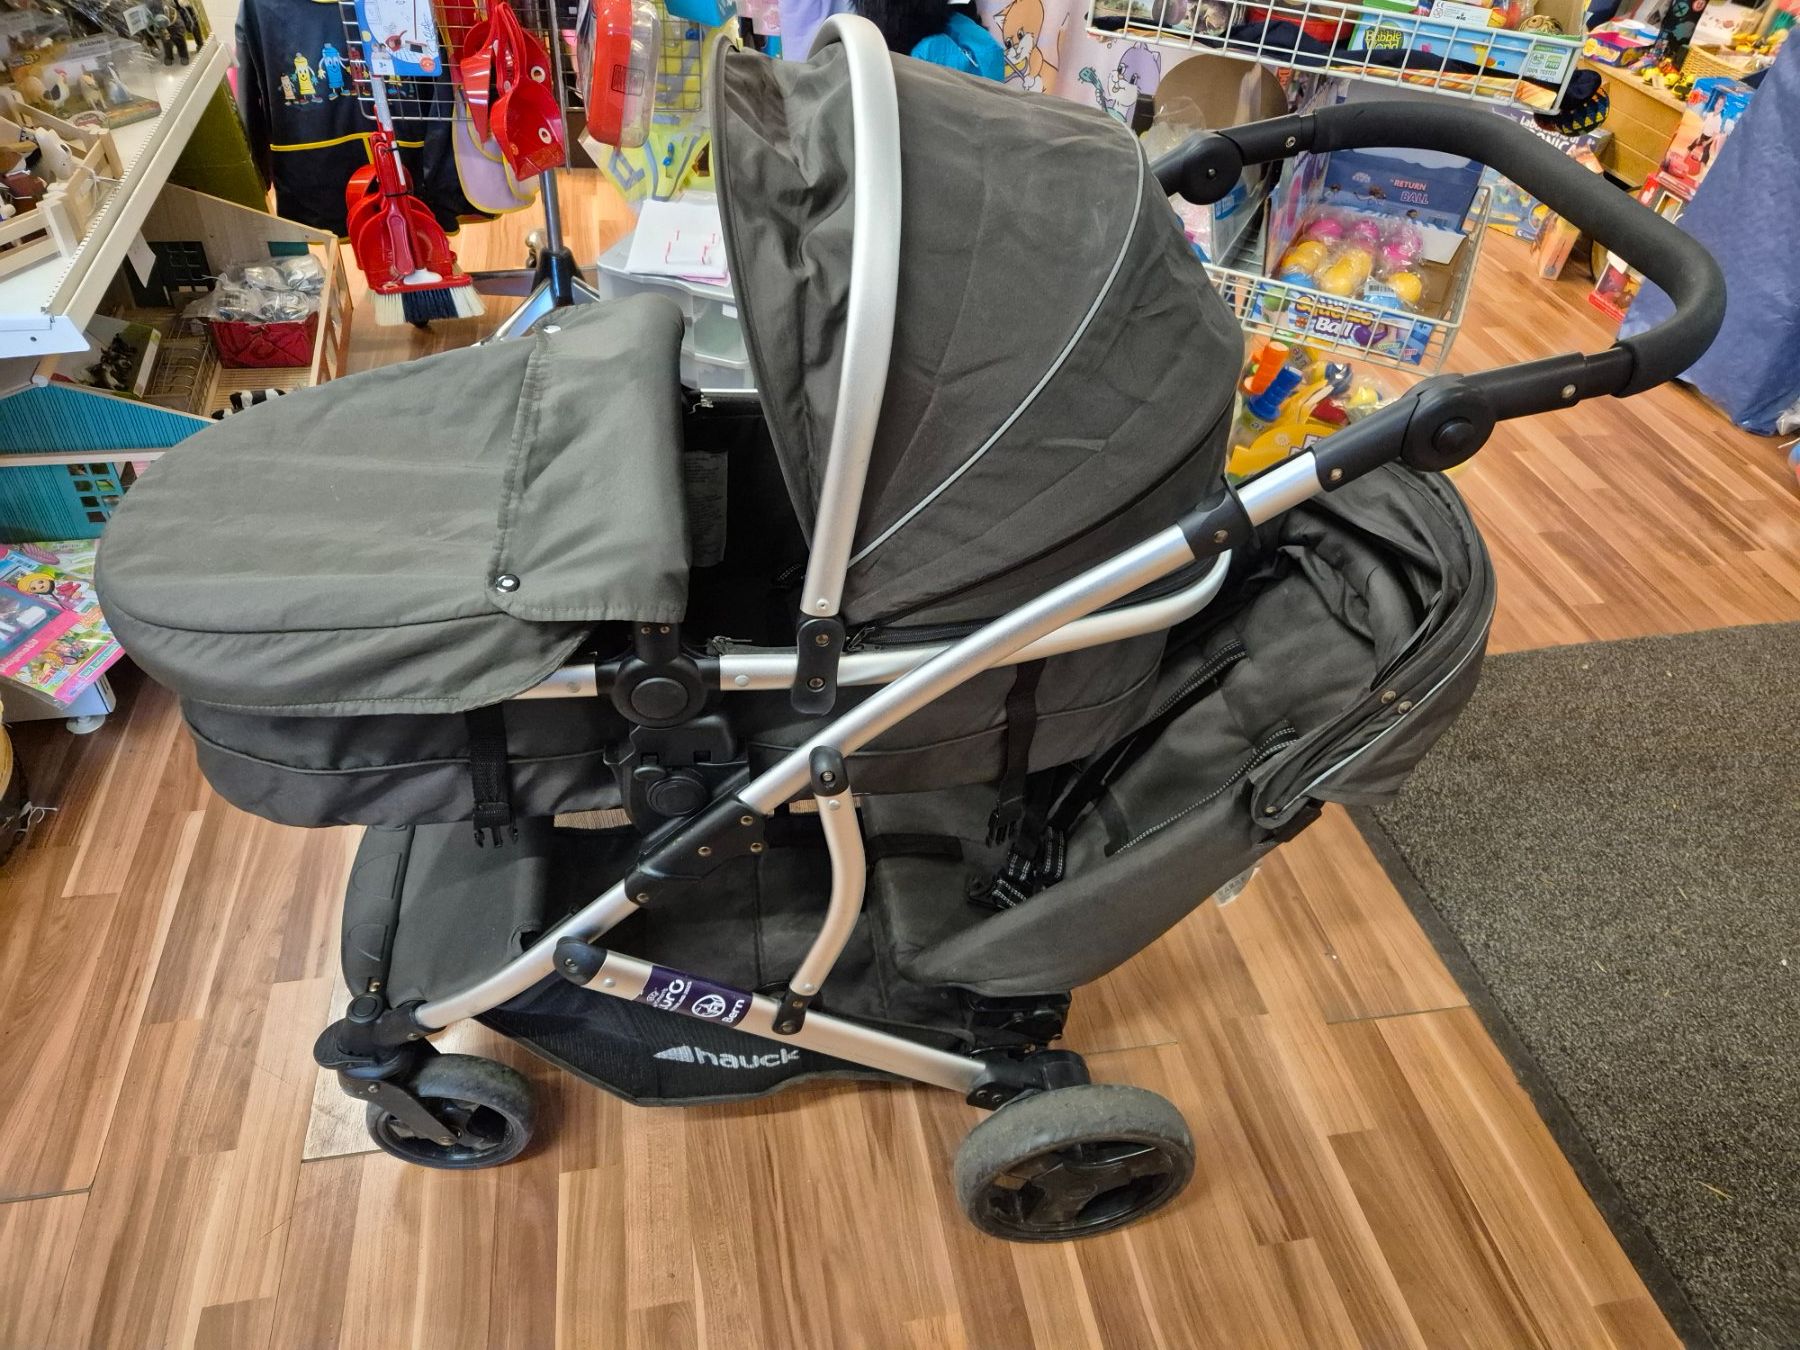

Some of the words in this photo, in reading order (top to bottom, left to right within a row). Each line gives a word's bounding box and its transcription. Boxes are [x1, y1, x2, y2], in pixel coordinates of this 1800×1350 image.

[1394, 179, 1426, 191] RETURN
[1401, 191, 1429, 205] BALL
[722, 999, 745, 1023] Bern
[694, 1046, 800, 1070] hauck
